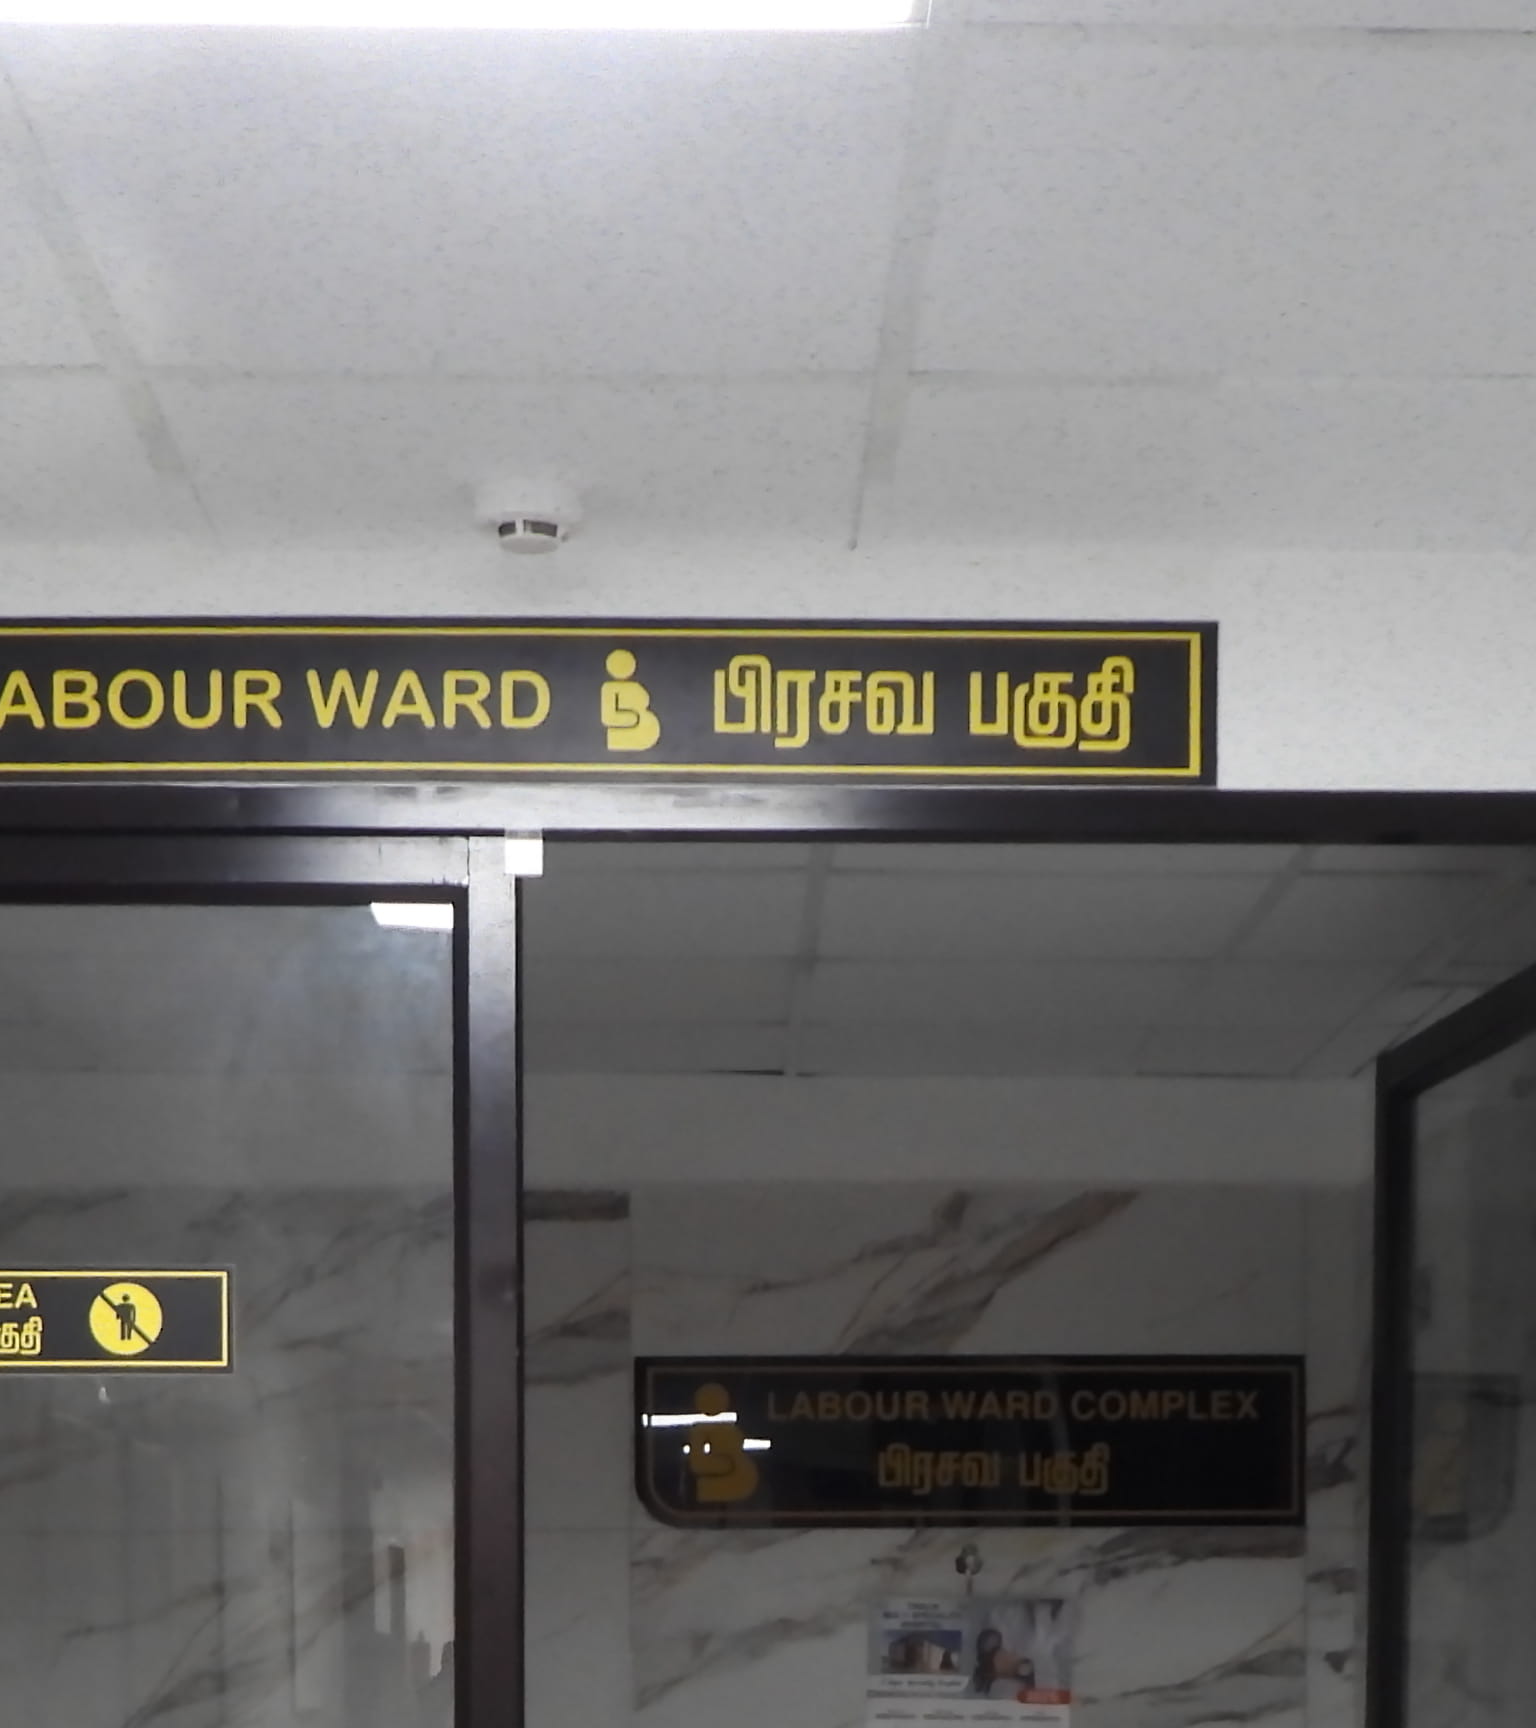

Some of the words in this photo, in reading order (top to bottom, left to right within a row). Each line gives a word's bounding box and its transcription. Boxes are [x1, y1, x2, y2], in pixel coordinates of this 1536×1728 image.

[308, 668, 551, 729] WARD
[713, 653, 935, 748] பிரசவ
[968, 655, 1135, 751] பகுதி
[766, 1390, 930, 1421] LABOUR
[941, 1389, 1060, 1421] WARD
[1070, 1389, 1261, 1421] COMPLEX
[877, 1442, 1001, 1495] பிரசவ
[1018, 1442, 1110, 1495] பகுதி
